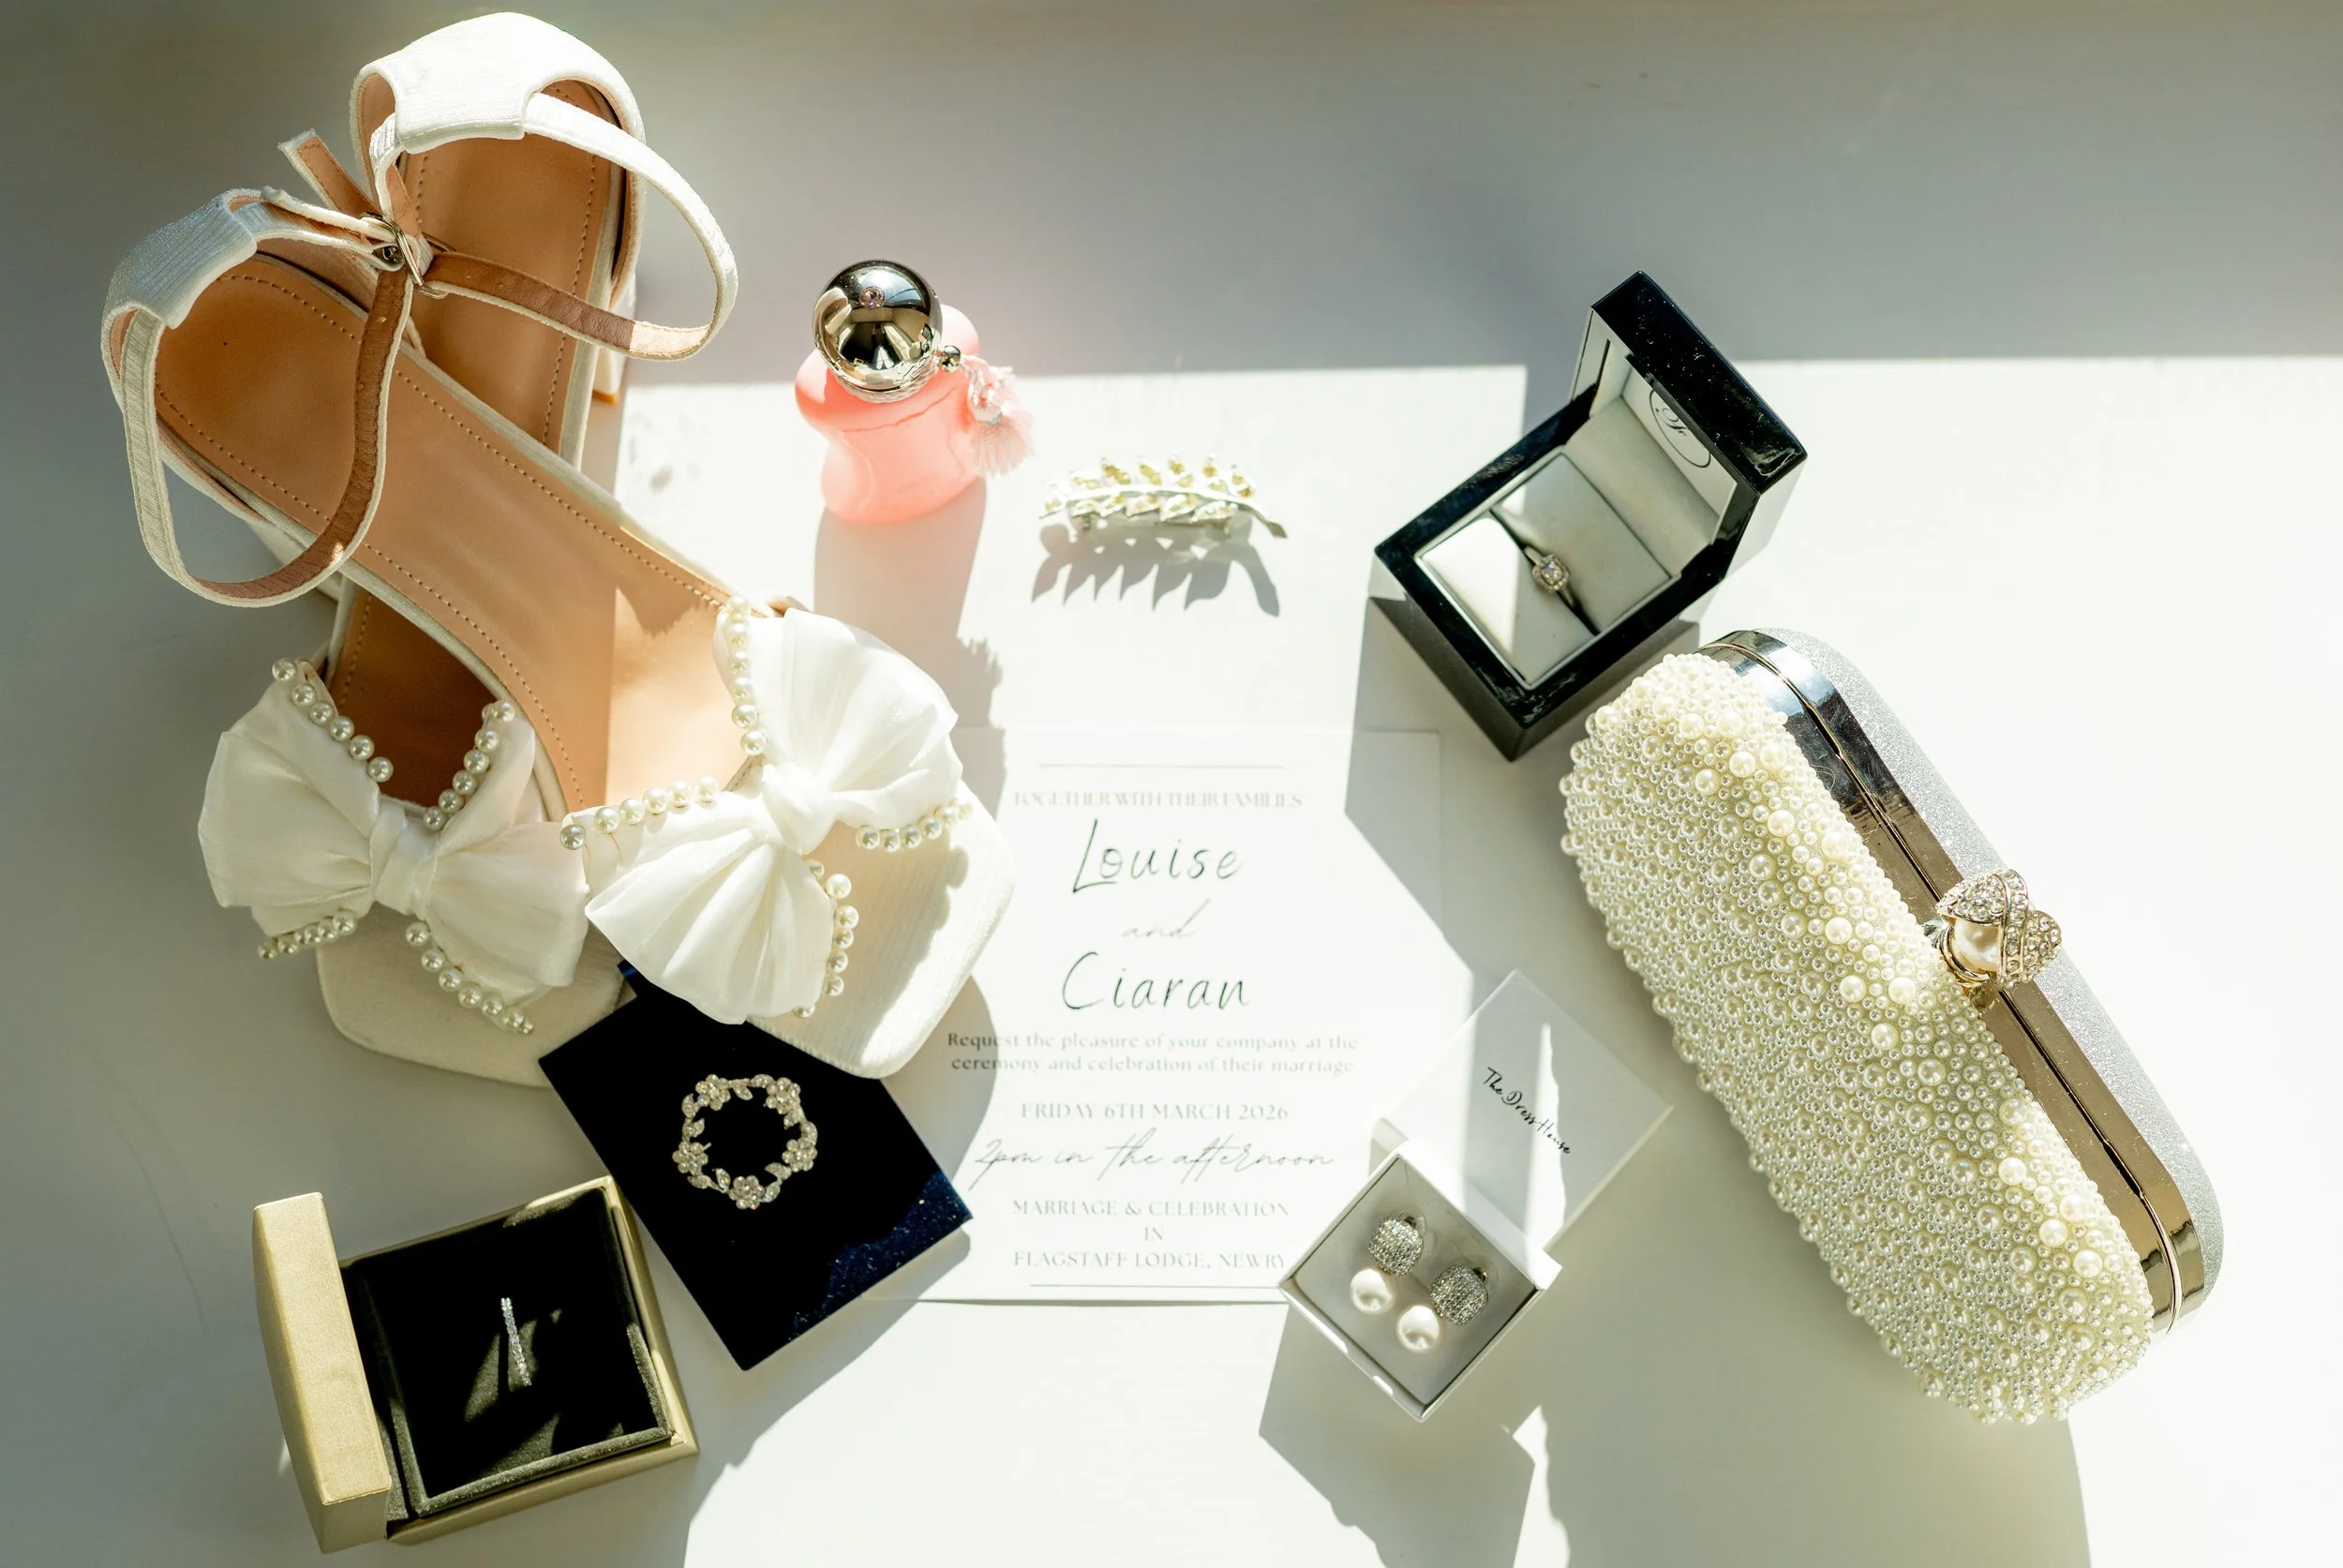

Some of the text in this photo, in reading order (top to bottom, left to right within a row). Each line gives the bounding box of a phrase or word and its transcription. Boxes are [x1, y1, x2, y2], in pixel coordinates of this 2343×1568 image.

[1114, 791, 1161, 806] WITH
[1167, 791, 1218, 807] THEIR
[1223, 792, 1302, 808] FAMILIES
[1071, 817, 1245, 894] Louise
[1121, 898, 1212, 938] and
[1062, 950, 1250, 1010] Ciaran
[948, 1032, 1358, 1053] Request the pleasure of your company at the
[951, 1055, 1354, 1077] ceremony and celebration of their marriage
[1021, 1102, 1289, 1121] FRIDAY 6TH MARCH 2026
[1483, 1066, 1571, 1154] The Dress House
[969, 1127, 1335, 1190] 2pm in the afternoon
[1013, 1200, 1290, 1217] MARRIAGE & CELEBRATION
[1143, 1225, 1164, 1242] IN
[1014, 1251, 1285, 1269] FLAGSTAFF LODGE, NEWRY
